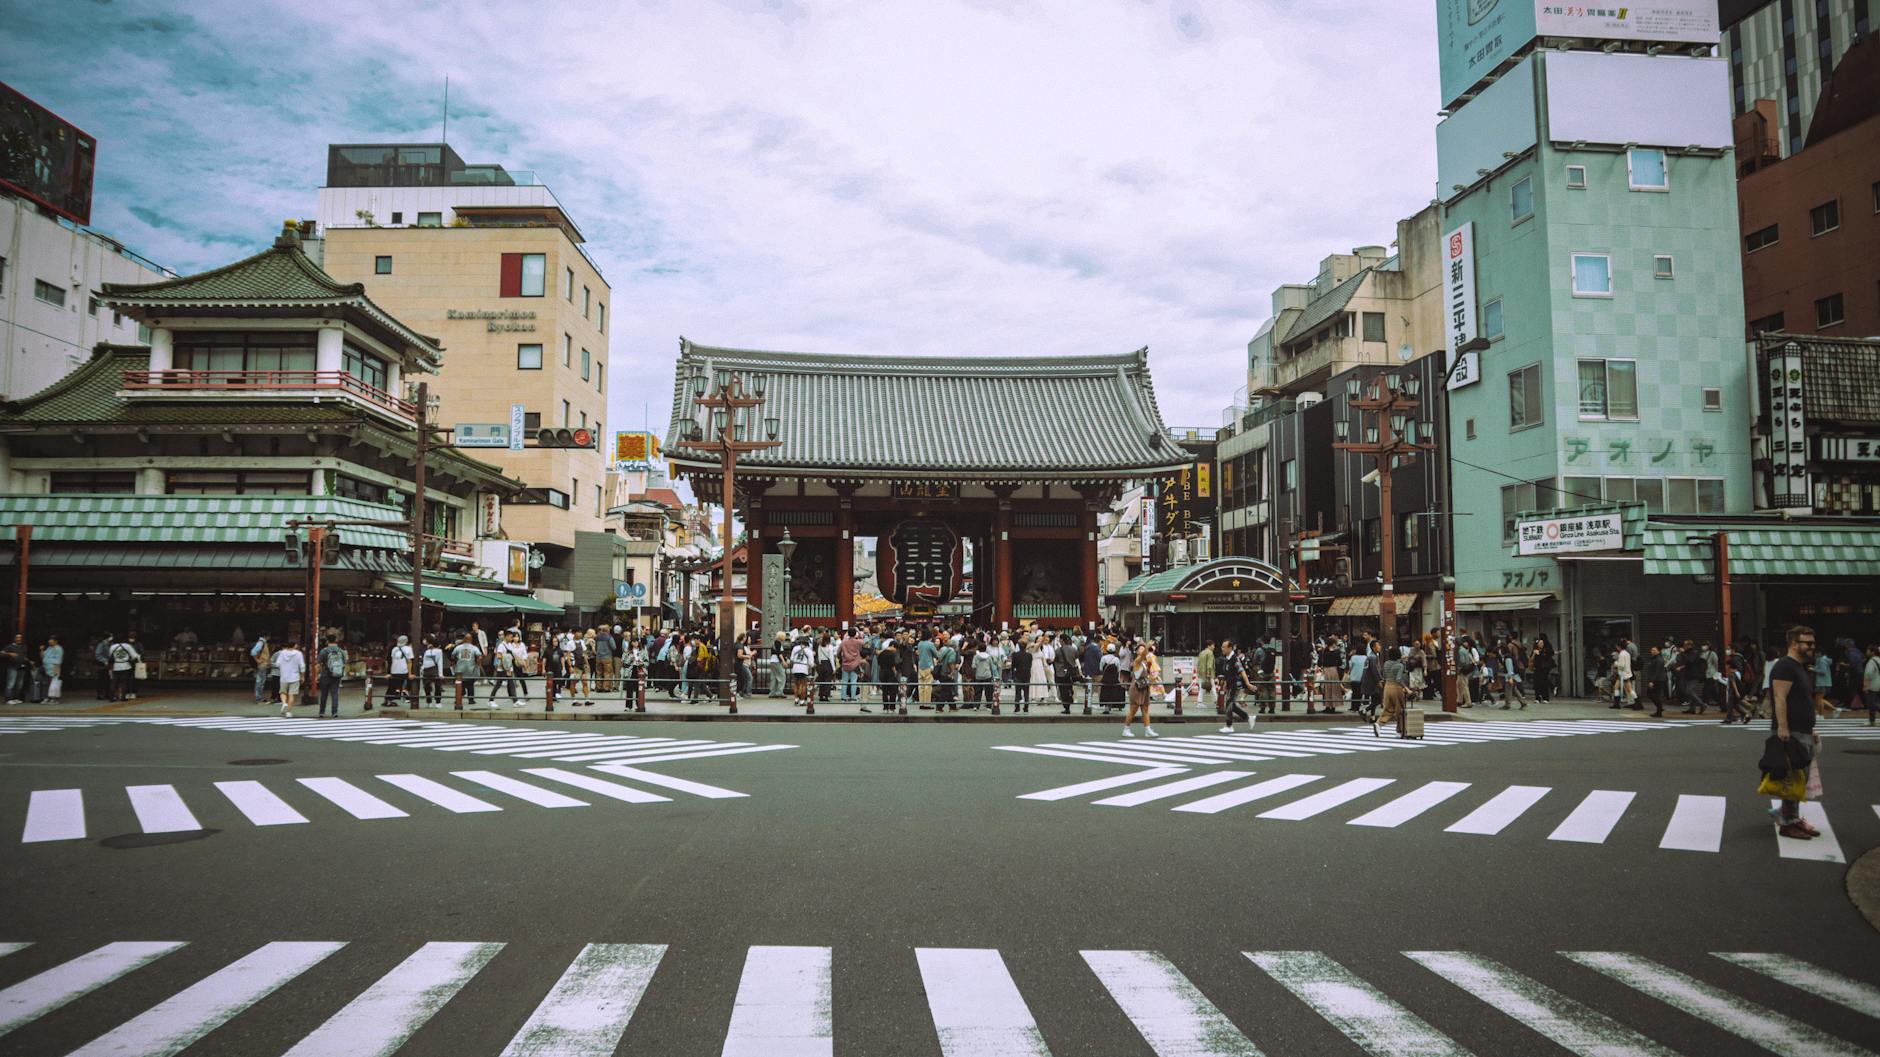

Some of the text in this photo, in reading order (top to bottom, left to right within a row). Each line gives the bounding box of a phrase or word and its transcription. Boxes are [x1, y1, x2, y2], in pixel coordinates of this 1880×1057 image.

[447, 309, 536, 320] Kaminarimon
[487, 321, 535, 334] Ryokan
[1567, 439, 1714, 463] アオノヤ
[1522, 519, 1611, 535] 地下鉄 銀座線 浅草駅
[1586, 529, 1609, 537] Asakusa
[1503, 570, 1549, 589] アオノヤ
